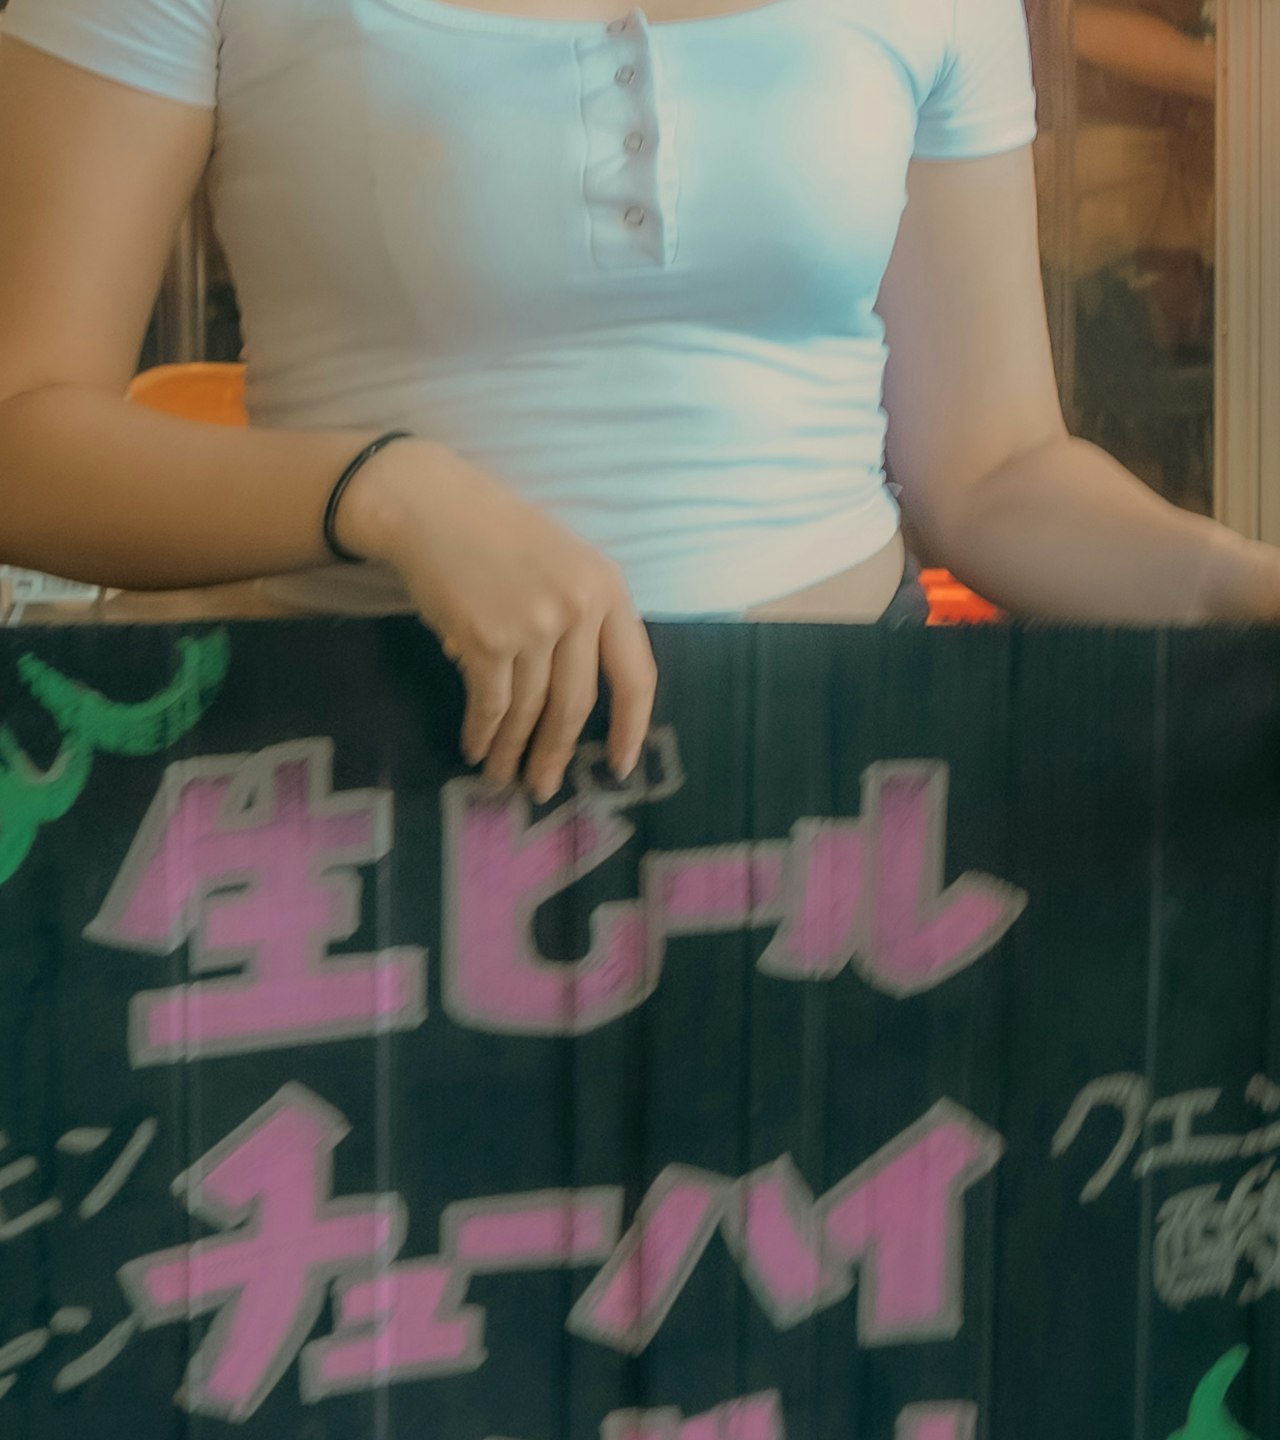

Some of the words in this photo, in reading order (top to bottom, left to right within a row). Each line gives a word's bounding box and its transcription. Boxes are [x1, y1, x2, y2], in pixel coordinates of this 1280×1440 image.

[82, 725, 1029, 1069] 生ビール
[118, 1080, 1005, 1423] チューハイ
